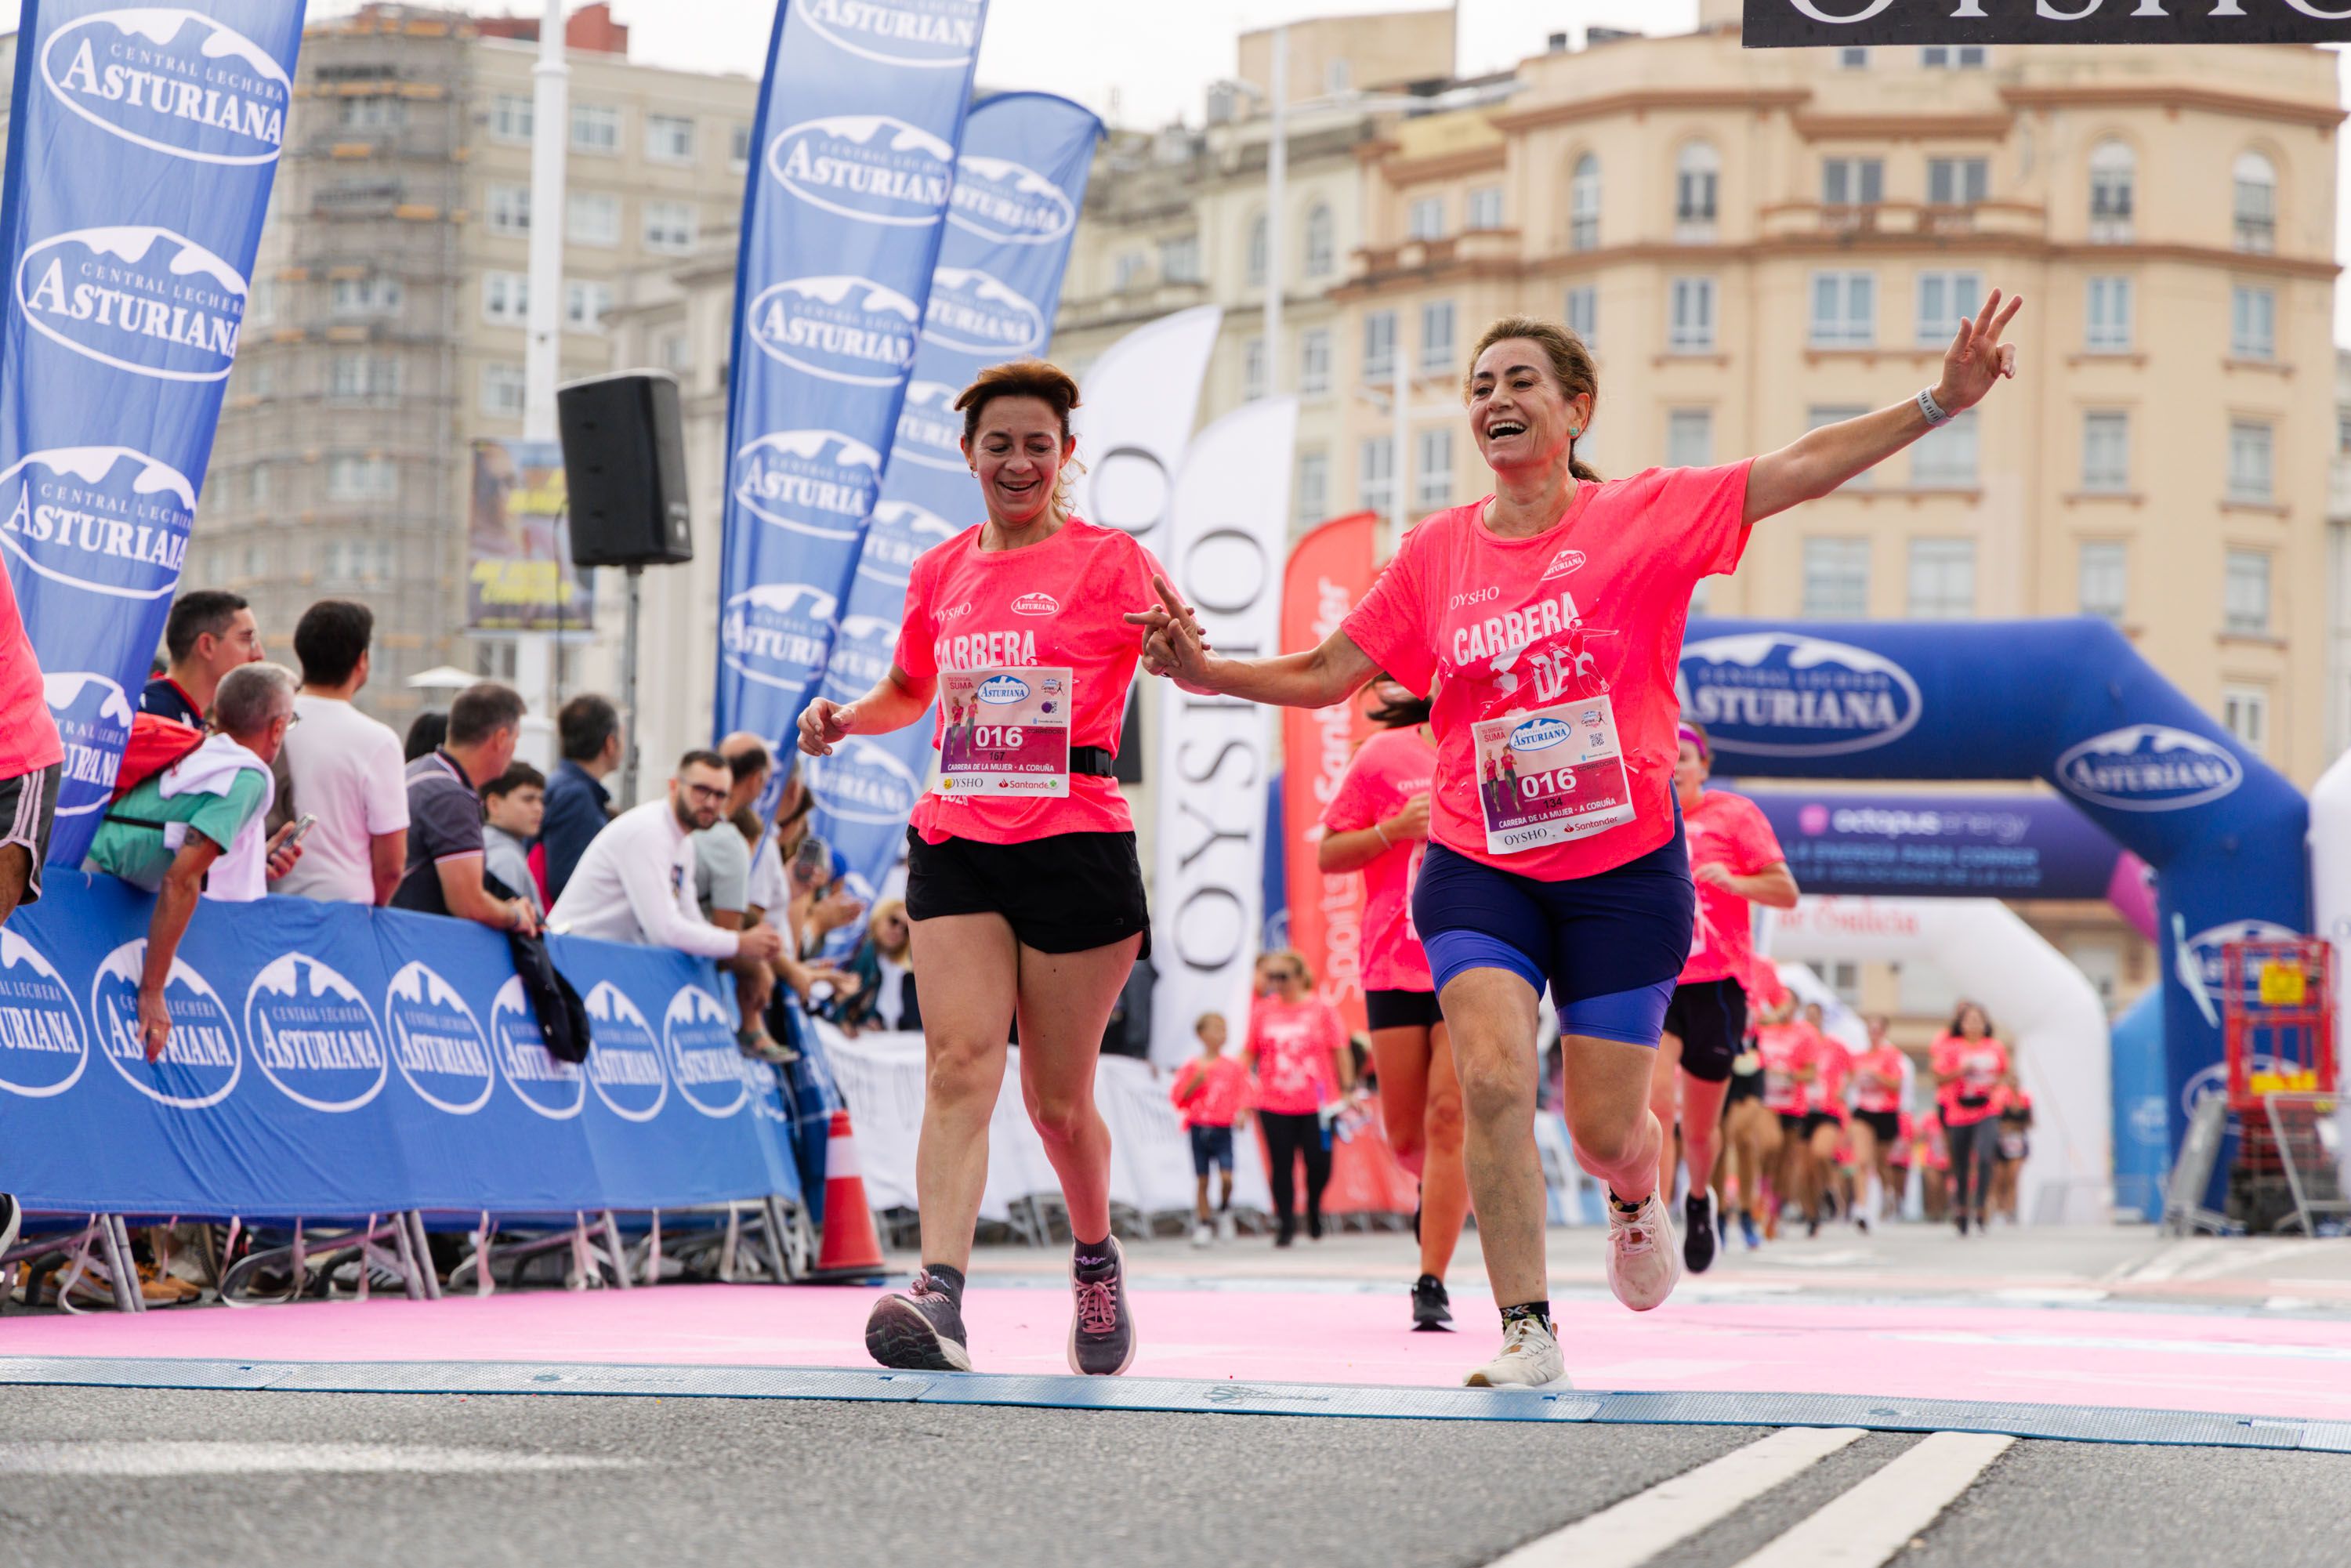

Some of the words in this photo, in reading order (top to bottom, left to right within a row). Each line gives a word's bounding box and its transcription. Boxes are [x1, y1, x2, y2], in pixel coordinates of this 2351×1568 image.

[110, 43, 198, 78] CENTRAL
[205, 66, 283, 103] LECHERA
[59, 37, 283, 147] ASTURIANA
[81, 262, 166, 296] CENTRAL
[40, 482, 128, 515] CENTRAL
[1451, 586, 1500, 610] OYSHO
[1454, 592, 1583, 667] CARRERA
[950, 682, 973, 690] SUMA
[981, 686, 1026, 697] ASTURIANA
[976, 726, 1023, 748] 016
[1484, 732, 1506, 742] SUMA
[1514, 728, 1567, 747] ASTURIANA
[1026, 763, 1055, 772] CORUÑA
[1009, 780, 1049, 789] Santande
[1521, 767, 1577, 798] 016
[1498, 817, 1527, 828] CARRERA
[1549, 807, 1574, 819] MUJER
[1586, 798, 1616, 811] CORUÑA
[1543, 796, 1563, 809] 134
[1504, 827, 1547, 846] OYSHO
[1574, 816, 1618, 831] Santander
[15, 980, 63, 1002] LECHERA
[259, 1008, 382, 1070] ASTURIANA
[394, 1011, 488, 1078] ASTURIANA
